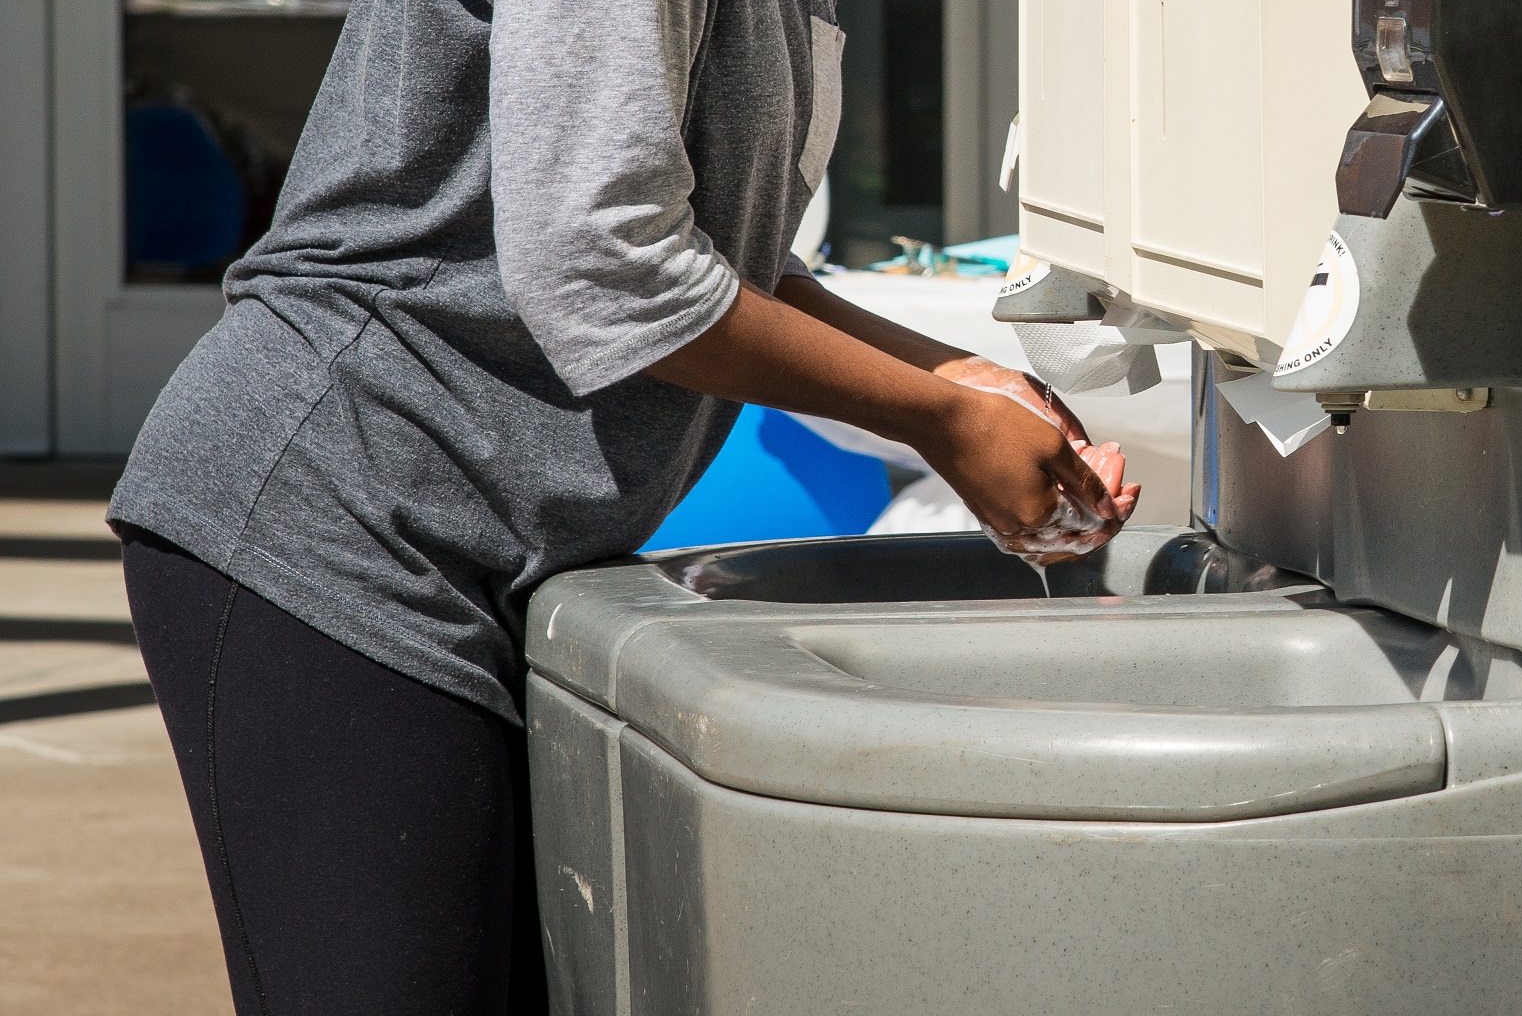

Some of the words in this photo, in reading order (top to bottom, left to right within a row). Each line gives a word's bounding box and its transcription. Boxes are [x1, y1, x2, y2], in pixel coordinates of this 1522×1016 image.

[1326, 234, 1346, 257] RINK!
[1009, 274, 1032, 292] ONLY
[1275, 358, 1301, 373] SHING
[1304, 337, 1333, 362] ONLY
